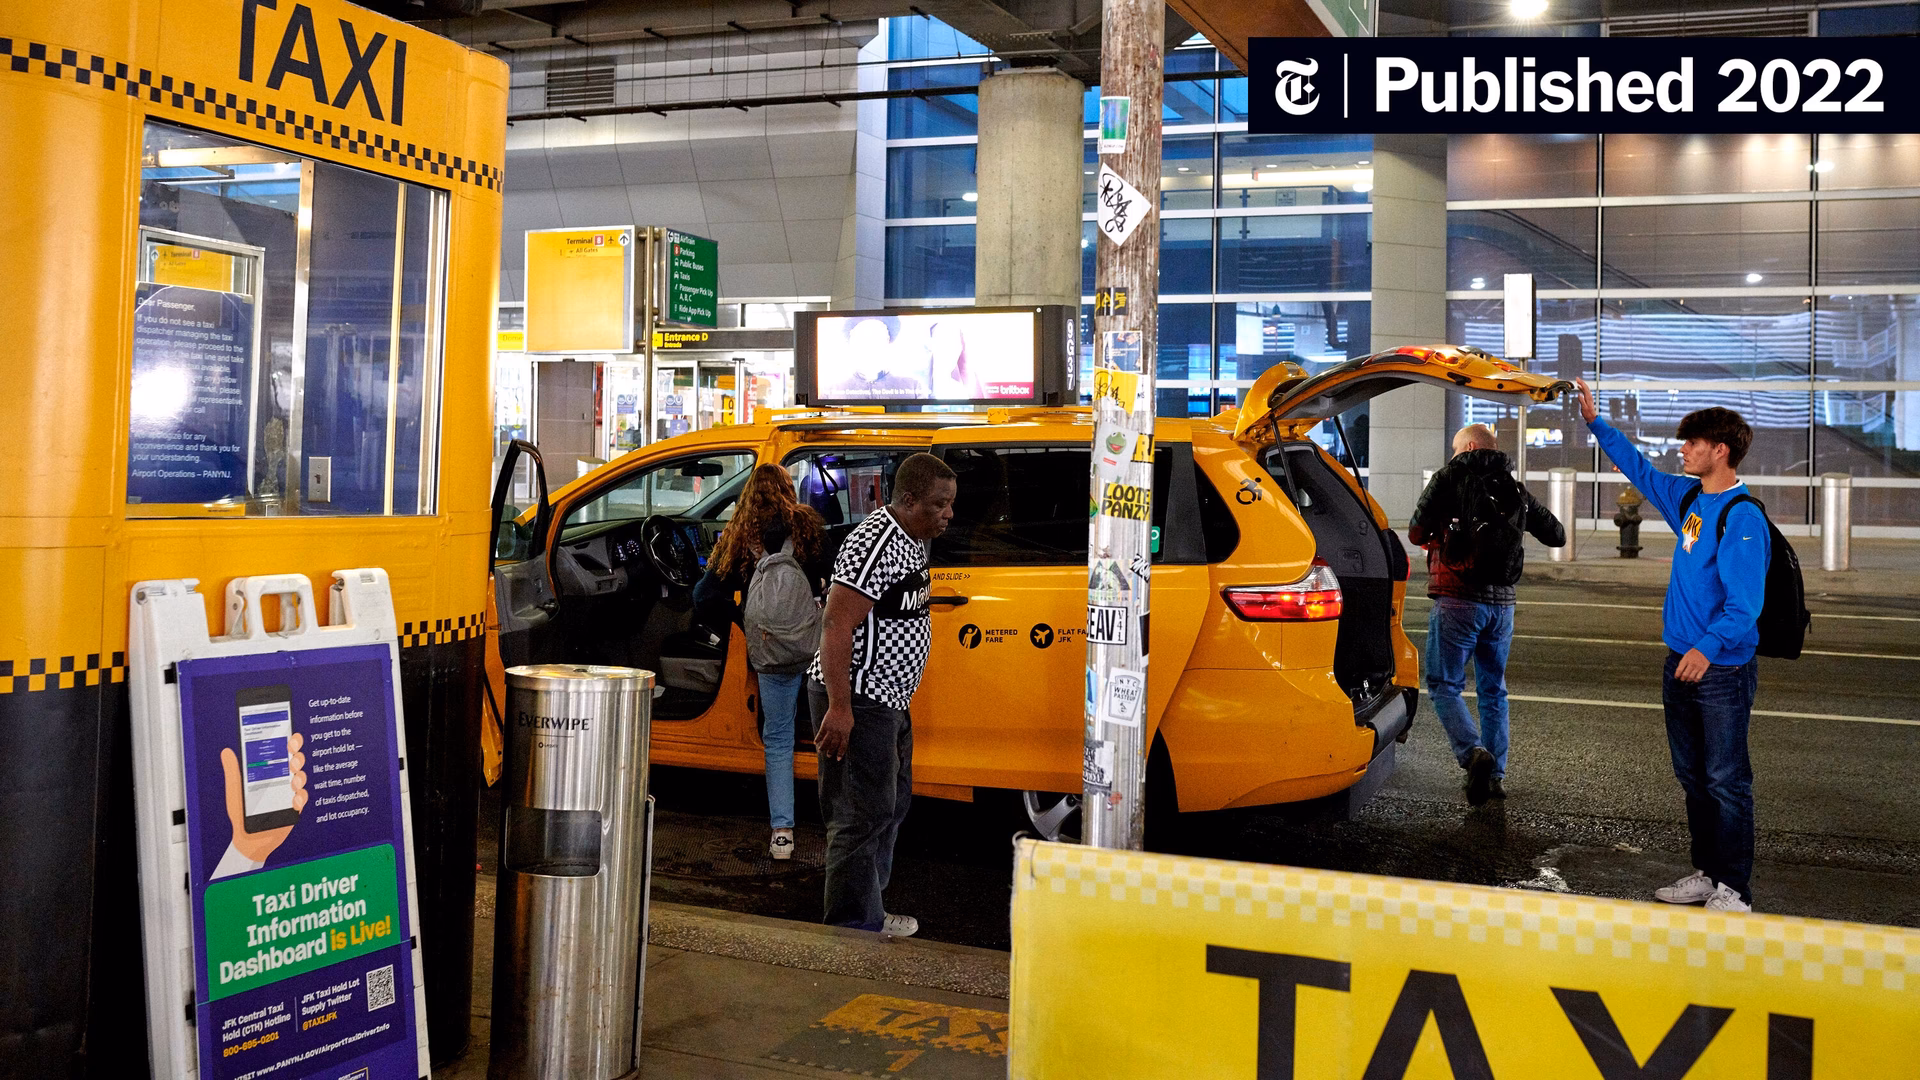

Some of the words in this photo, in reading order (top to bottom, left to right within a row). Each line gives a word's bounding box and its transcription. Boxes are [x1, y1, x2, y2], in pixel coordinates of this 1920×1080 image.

[238, 0, 407, 127] TAXI
[680, 247, 695, 259] Parking
[680, 260, 692, 269] Public
[692, 262, 704, 271] Buses
[680, 271, 690, 281] Taxis
[679, 283, 699, 296] Passenger
[157, 299, 196, 312] Passenger,
[679, 304, 688, 313] Ride
[143, 315, 157, 325] you
[159, 316, 168, 324] do
[170, 317, 181, 325] not
[183, 319, 195, 327] see
[196, 320, 202, 328] a
[203, 320, 215, 329] taxi
[136, 326, 174, 337] dispatcher
[175, 330, 208, 341] managing
[210, 332, 220, 340] the
[222, 333, 233, 341] taxi
[664, 333, 700, 341] Entrance
[702, 333, 709, 341] D
[173, 340, 197, 350] please
[198, 342, 225, 353] proceed
[226, 343, 232, 352] to
[233, 344, 243, 353] the
[231, 355, 244, 364] take
[1066, 320, 1074, 390] 9G37
[1000, 384, 1030, 395] britbox
[183, 432, 193, 441] for
[194, 433, 207, 442] any
[185, 442, 198, 452] and
[199, 442, 218, 452] thank
[219, 445, 230, 454] you
[231, 444, 240, 453] for
[132, 453, 149, 463] your
[131, 469, 156, 479] Airport
[158, 470, 195, 480] Operations
[1086, 607, 1117, 641] EAV
[308, 699, 320, 708] Get
[320, 695, 351, 707] up-to-date
[309, 712, 344, 724] information
[344, 710, 363, 720] before
[311, 732, 323, 742] you
[323, 730, 334, 741] get
[334, 729, 340, 737] to
[341, 727, 351, 736] the
[312, 747, 333, 758] airport
[332, 745, 346, 754] hold
[346, 743, 355, 752] lot
[313, 763, 324, 773] like
[324, 762, 335, 771] the
[335, 759, 358, 770] average
[314, 780, 327, 790] wait
[327, 778, 343, 788] time,
[343, 774, 366, 785] number
[315, 797, 323, 807] of
[322, 795, 336, 805] taxis
[336, 788, 370, 803] dispatched,
[316, 813, 328, 823] and
[328, 811, 337, 820] lot
[337, 806, 370, 819] occupancy.
[252, 884, 296, 917] Taxi
[301, 873, 359, 905] Driver
[246, 898, 367, 948] Information
[219, 932, 327, 985] Dashboard
[330, 928, 347, 951] is
[351, 915, 392, 946] Live!
[301, 992, 315, 1004] JFK
[315, 986, 331, 999] Taxi
[331, 980, 348, 994] Hold
[348, 977, 360, 988] Lot
[301, 1001, 326, 1016] Supply
[327, 992, 353, 1007] Twitter
[222, 1017, 237, 1030] JFK
[238, 1007, 267, 1025] Central
[267, 1001, 284, 1015] Taxi
[302, 1010, 338, 1031] @TAXIJFK
[222, 1028, 241, 1042] Hold
[242, 1021, 263, 1037] (CTH)
[264, 1013, 291, 1029] Hotline
